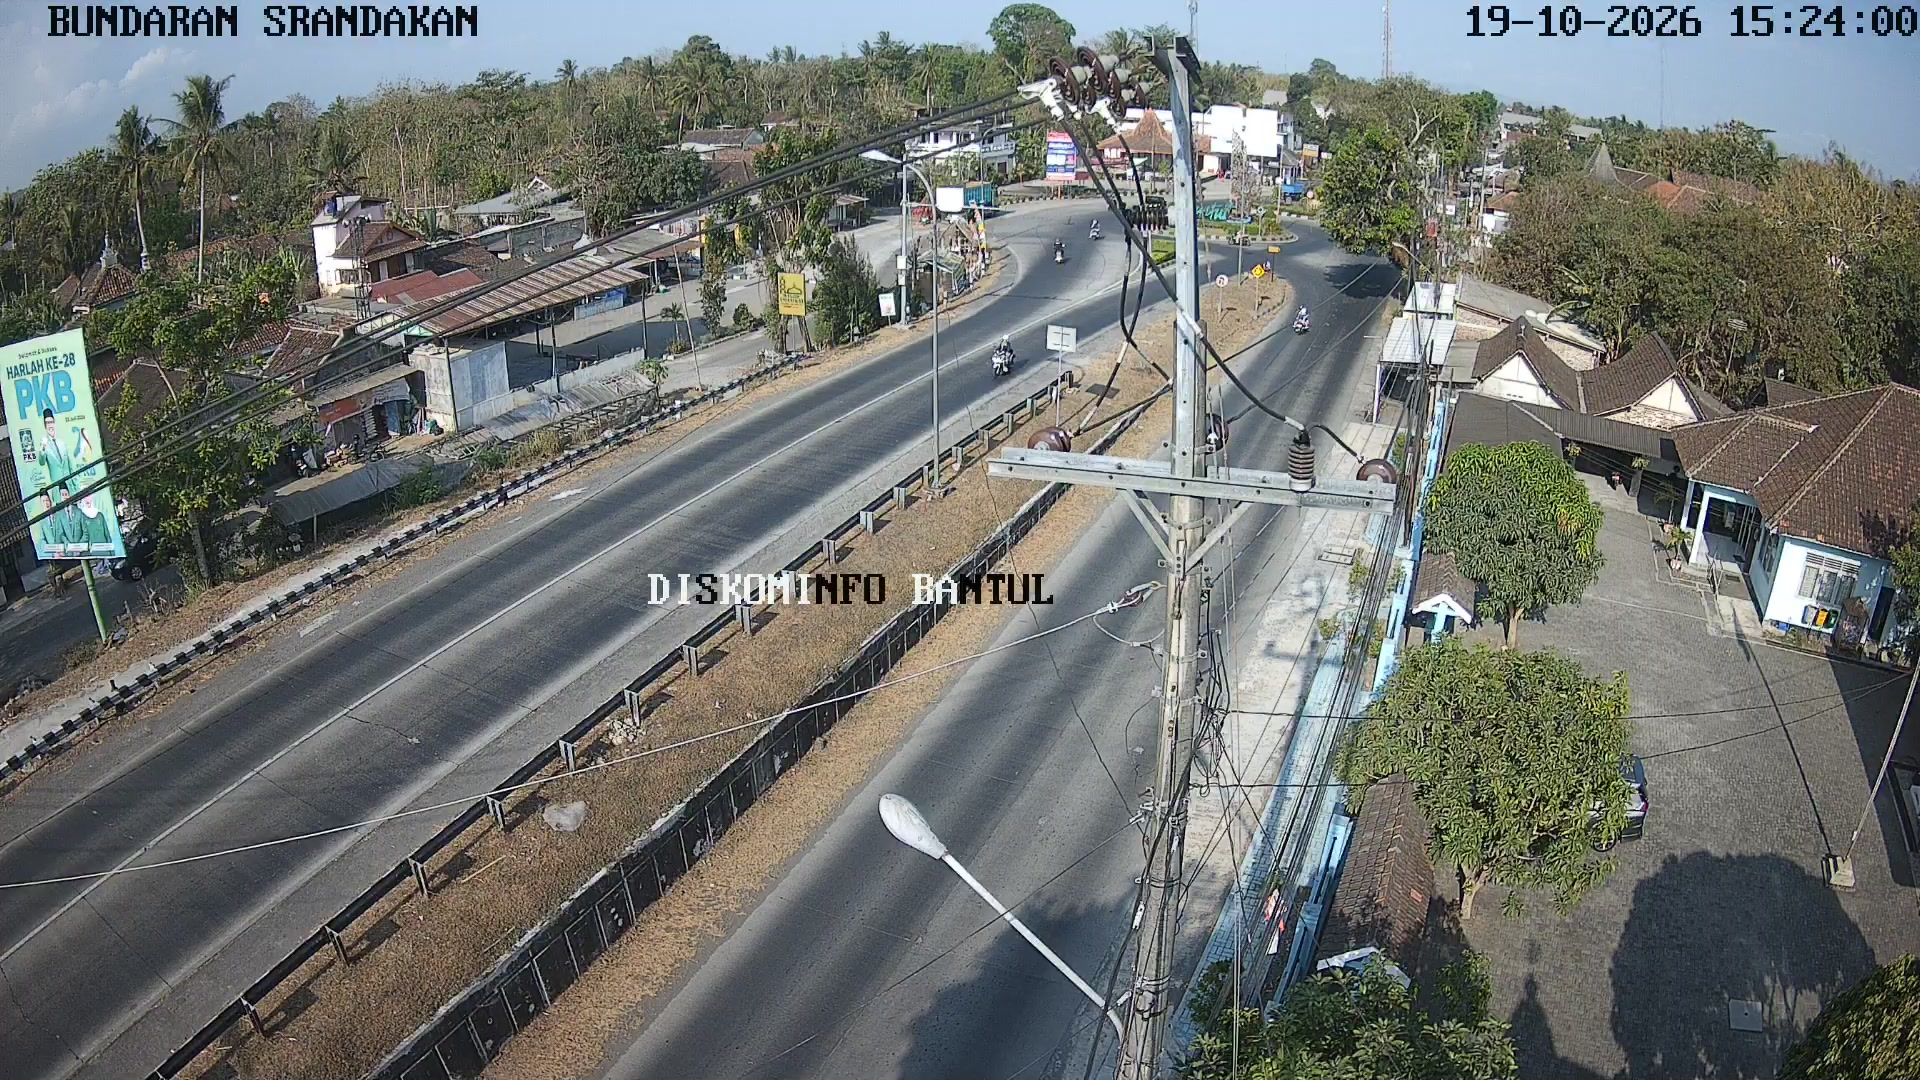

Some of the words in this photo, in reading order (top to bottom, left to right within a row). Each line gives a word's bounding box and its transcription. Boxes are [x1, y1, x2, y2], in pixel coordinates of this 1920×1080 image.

[6, 359, 44, 380] HARLAH
[45, 352, 76, 371] KE-28
[14, 370, 76, 420] PKB
